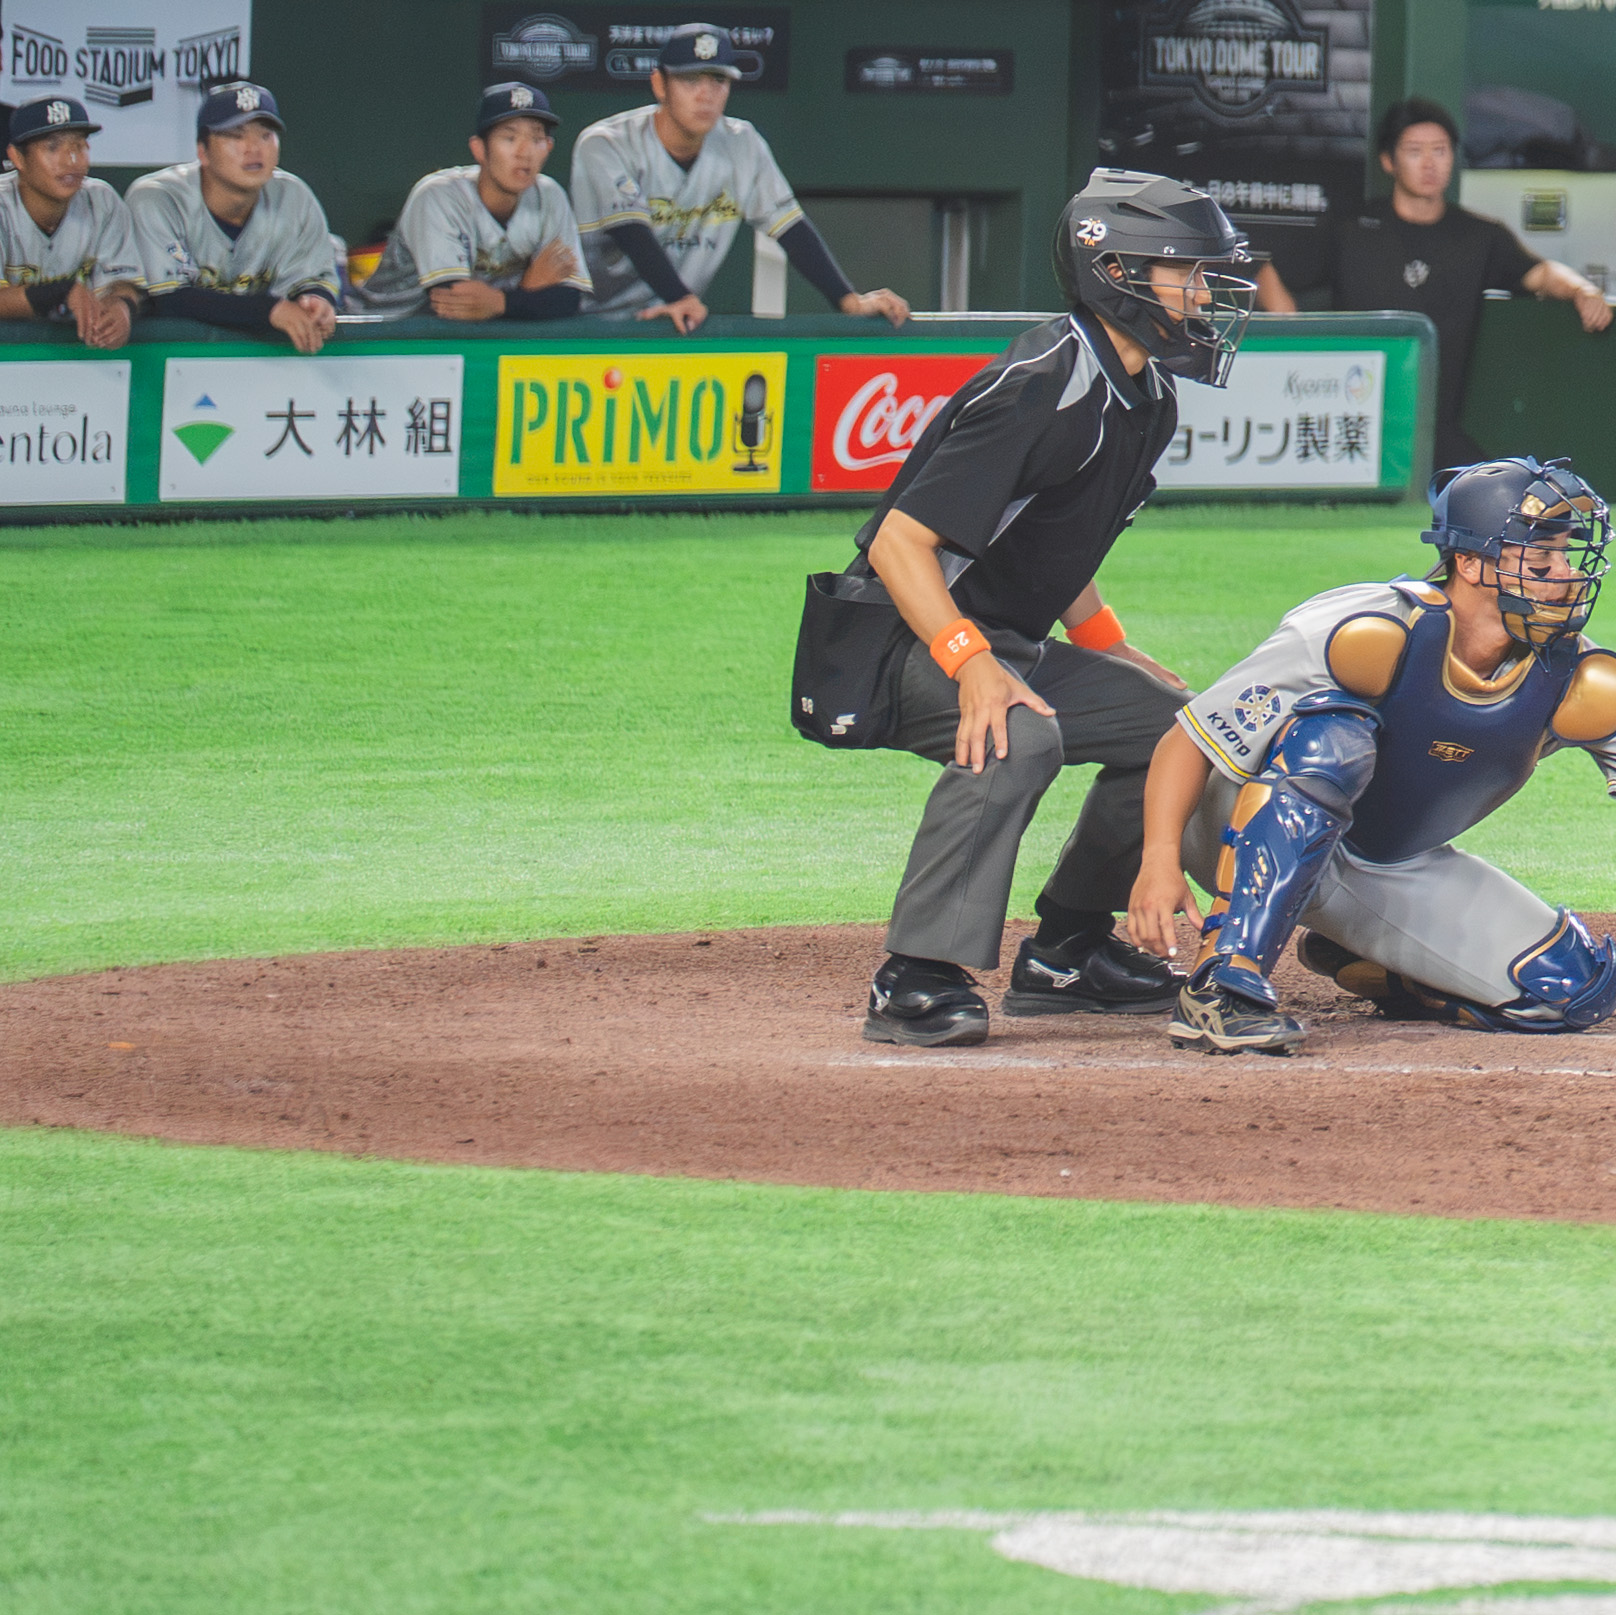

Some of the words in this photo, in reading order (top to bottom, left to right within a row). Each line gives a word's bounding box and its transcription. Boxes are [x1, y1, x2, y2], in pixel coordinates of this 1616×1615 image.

[11, 33, 67, 76] FOOD
[75, 45, 165, 85] STADIUM
[173, 36, 240, 81] TOKYO
[1154, 36, 1213, 72] TOKYO
[1214, 39, 1267, 73] DOME
[1269, 40, 1319, 79] TOUR
[1076, 219, 1107, 242] 29
[264, 397, 452, 457] 大林組
[1168, 412, 1370, 465] ョーリン製薬
